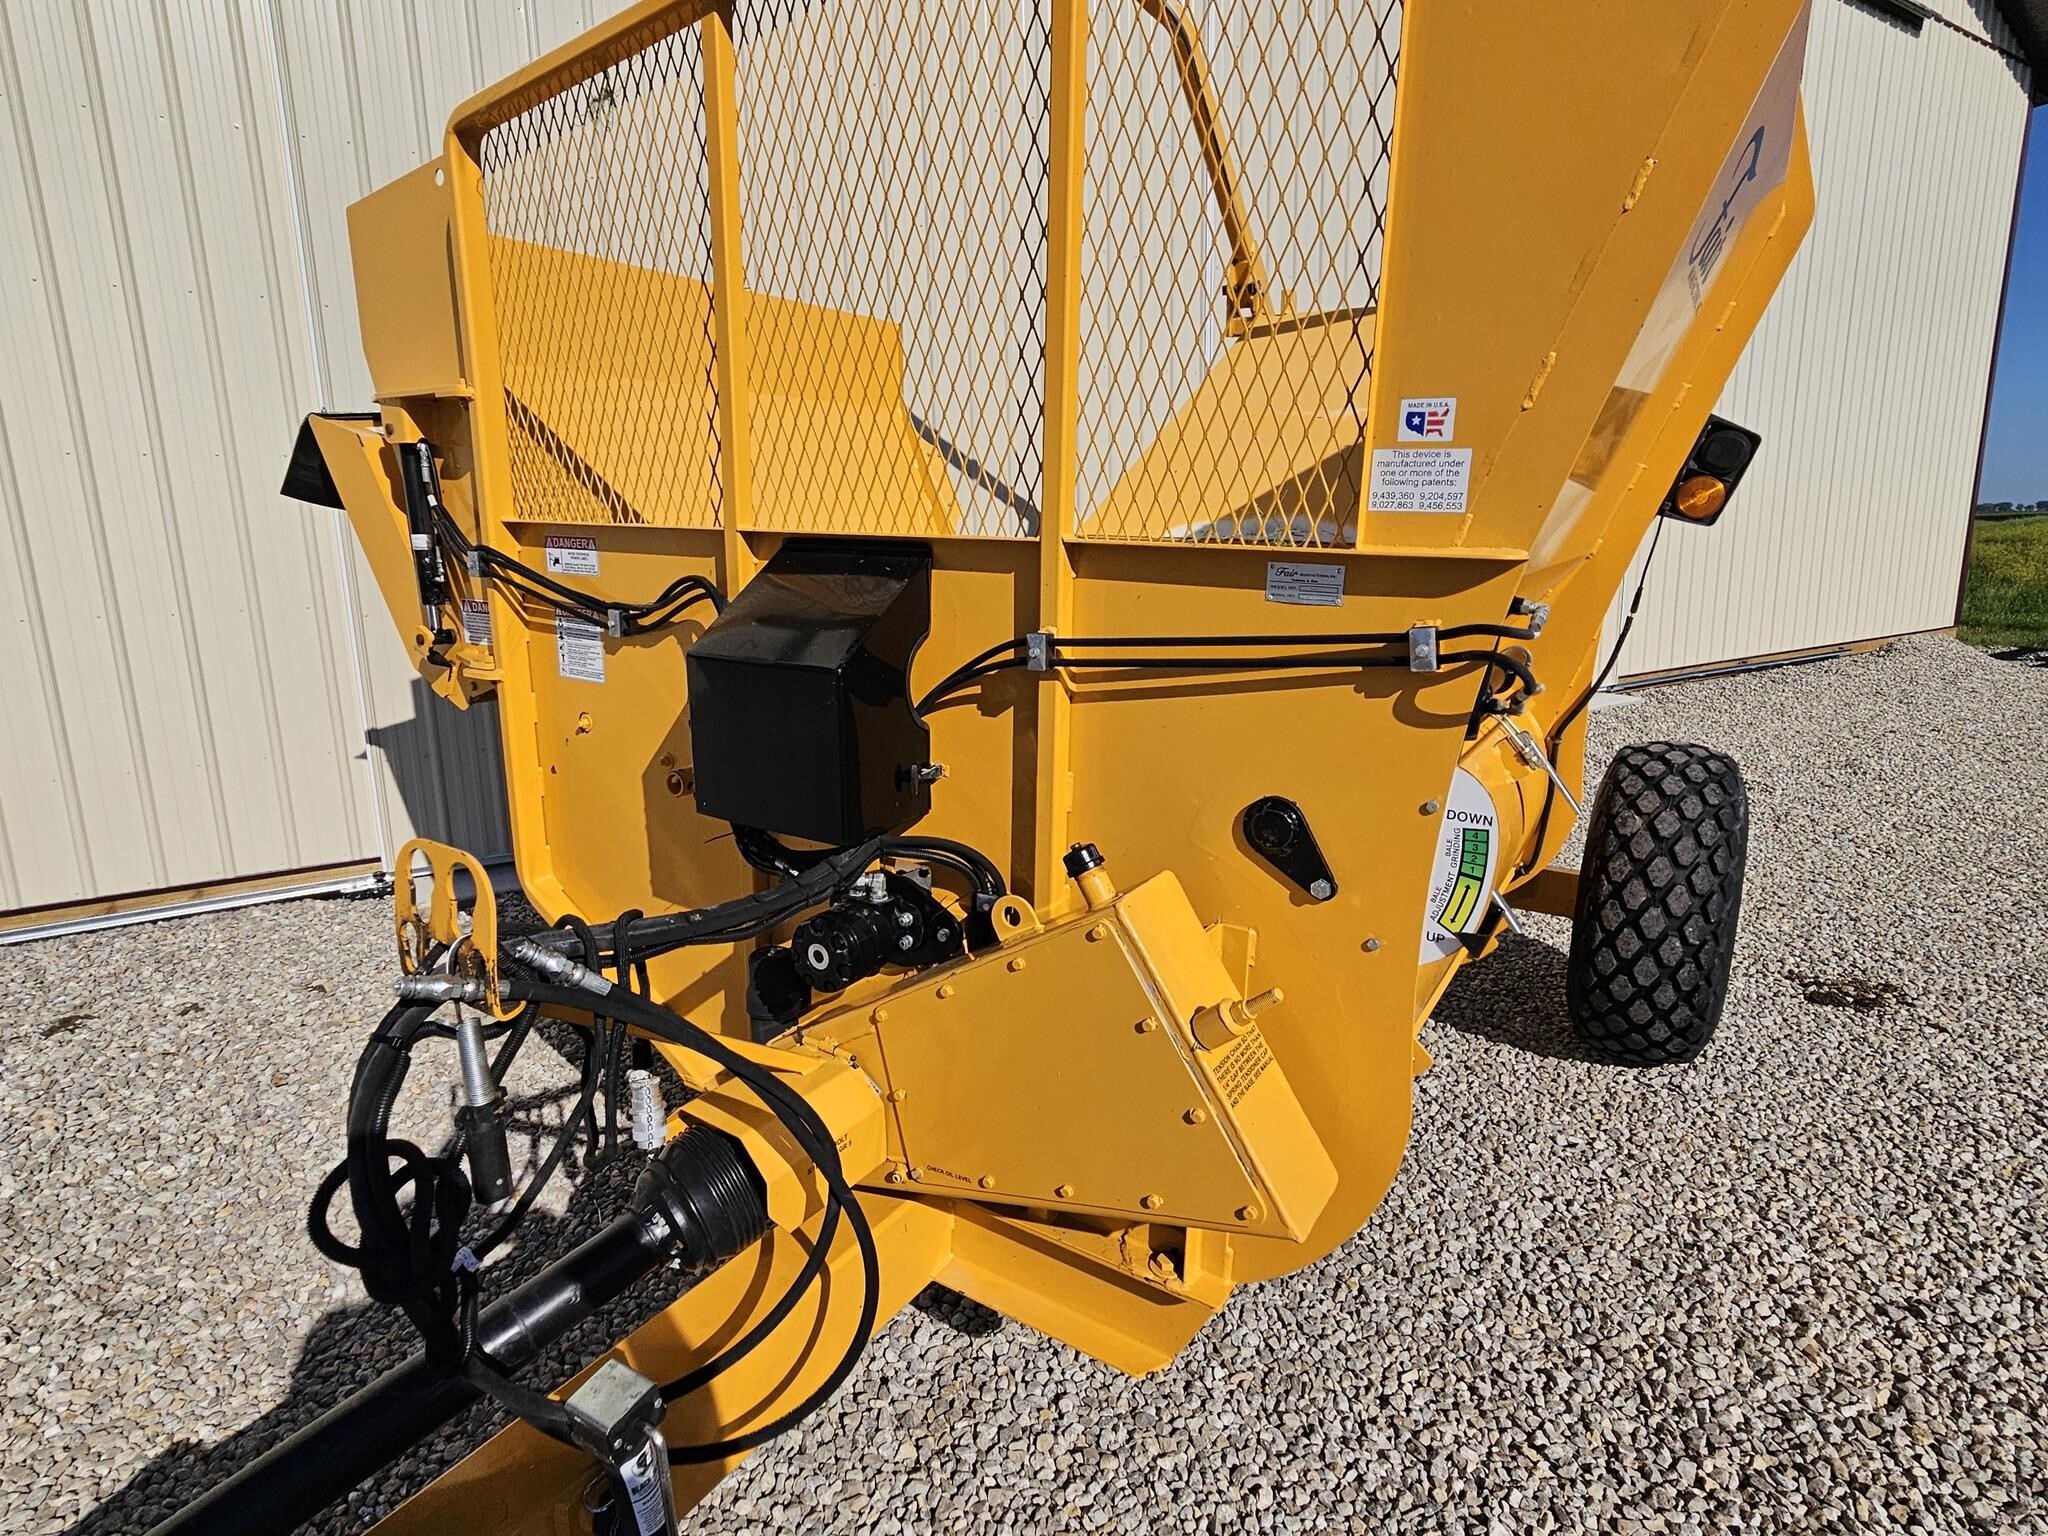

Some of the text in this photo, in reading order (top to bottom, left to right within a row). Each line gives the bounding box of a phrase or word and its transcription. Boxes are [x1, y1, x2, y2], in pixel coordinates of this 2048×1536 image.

[1382, 478, 1457, 488] following patents:
[1372, 492, 1464, 501] 9,439,360 9,204,597
[1371, 501, 1462, 510] 9,027,863 9,456,553
[553, 538, 588, 549] DANGER
[1275, 567, 1298, 577] Fair
[472, 603, 488, 613] DAN
[1446, 810, 1493, 827] DOWN
[1451, 828, 1461, 868] GRINDING
[1430, 886, 1442, 903] BALE
[1430, 872, 1455, 921] ADJUSTMENT
[1426, 931, 1445, 943] UP
[927, 1165, 944, 1174] CHECK
[955, 1174, 972, 1183] LEVEL
